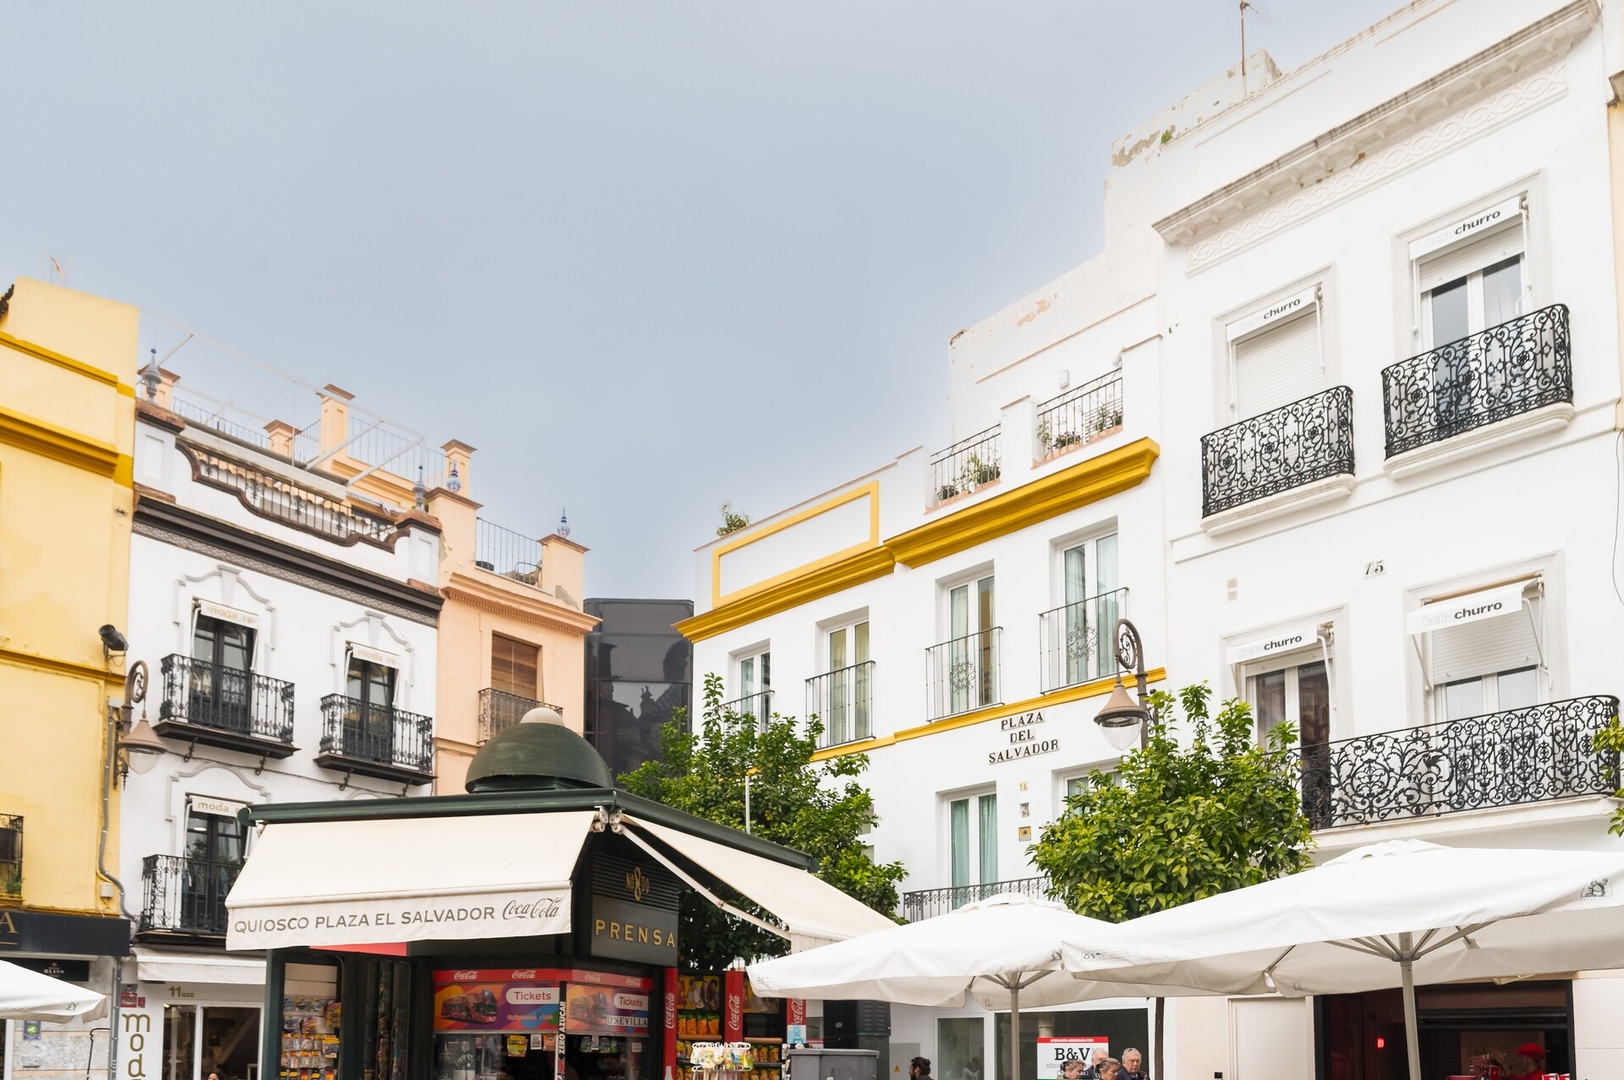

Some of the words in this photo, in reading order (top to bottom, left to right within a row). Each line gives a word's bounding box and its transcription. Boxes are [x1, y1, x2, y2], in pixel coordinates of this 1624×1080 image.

[1001, 711, 1044, 731] PLAZA
[1010, 729, 1035, 744] DEL
[988, 738, 1060, 764] SALVADOR
[197, 801, 229, 813] moda
[234, 916, 310, 934] QUIOSCO
[314, 913, 370, 929] PLAZA
[375, 912, 396, 926] EL
[400, 906, 496, 924] SALVADOR
[502, 896, 563, 920] Coca-Cola
[594, 918, 676, 949] PRENSA
[453, 970, 479, 981] Coca-Cola
[511, 969, 537, 980] Coca-Cola
[513, 991, 552, 1001] Tickets
[618, 996, 643, 1008] Tickets
[665, 992, 675, 1030] Coca-Cola
[728, 993, 741, 1031] Coca-Cola
[121, 1013, 151, 1080] mod
[1054, 1048, 1090, 1060] B&V
